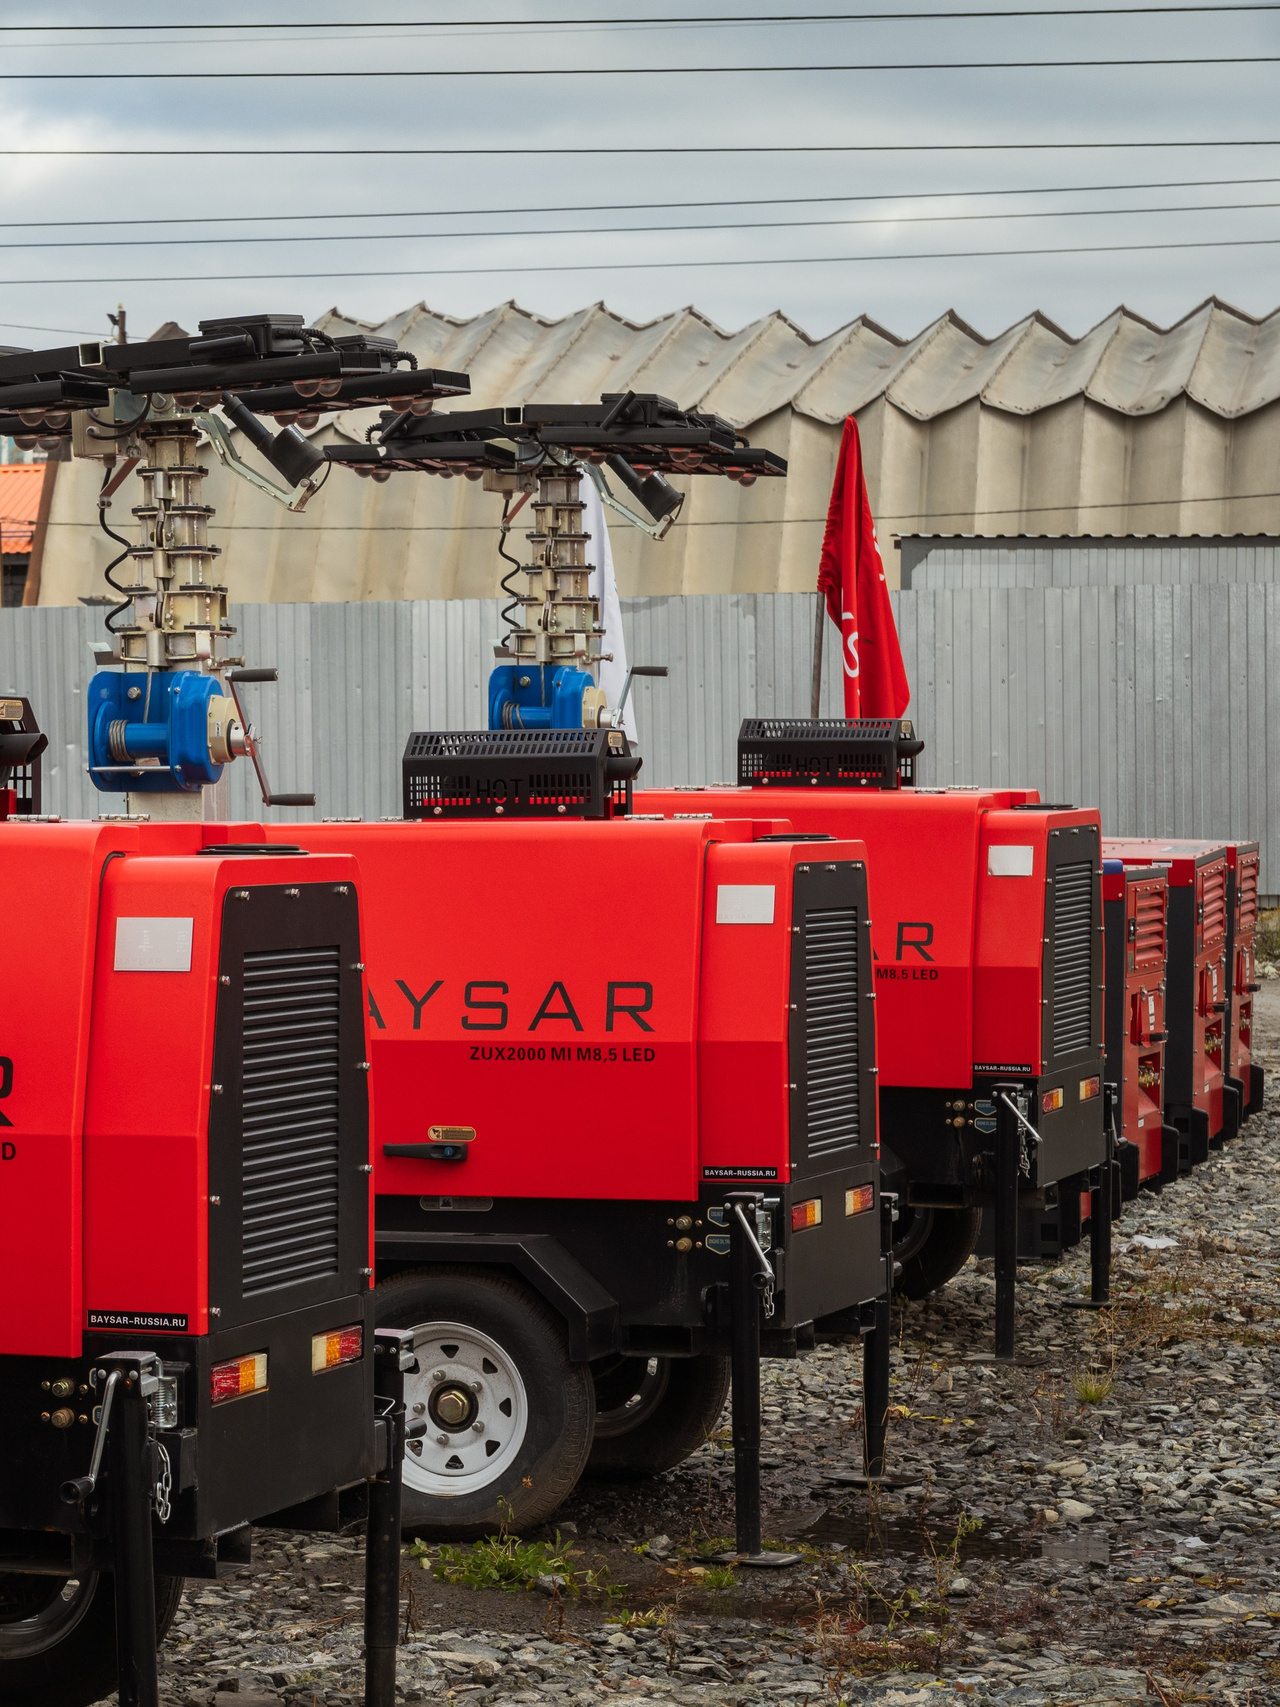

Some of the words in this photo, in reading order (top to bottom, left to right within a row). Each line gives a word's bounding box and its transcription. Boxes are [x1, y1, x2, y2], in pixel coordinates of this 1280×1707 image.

[796, 757, 834, 776] HOT
[476, 779, 524, 803] HOT
[873, 922, 935, 961] R
[876, 968, 909, 980] M8,5
[913, 969, 939, 980] LED
[470, 1046, 546, 1061] ZUX2000
[551, 1047, 571, 1061] MI
[577, 1048, 617, 1063] M8,5
[623, 1048, 655, 1062] LED
[704, 1169, 776, 1177] BAYSAR-RUSSIA.RU
[90, 1314, 186, 1327] BAYSAR-RUSSIA.RU
